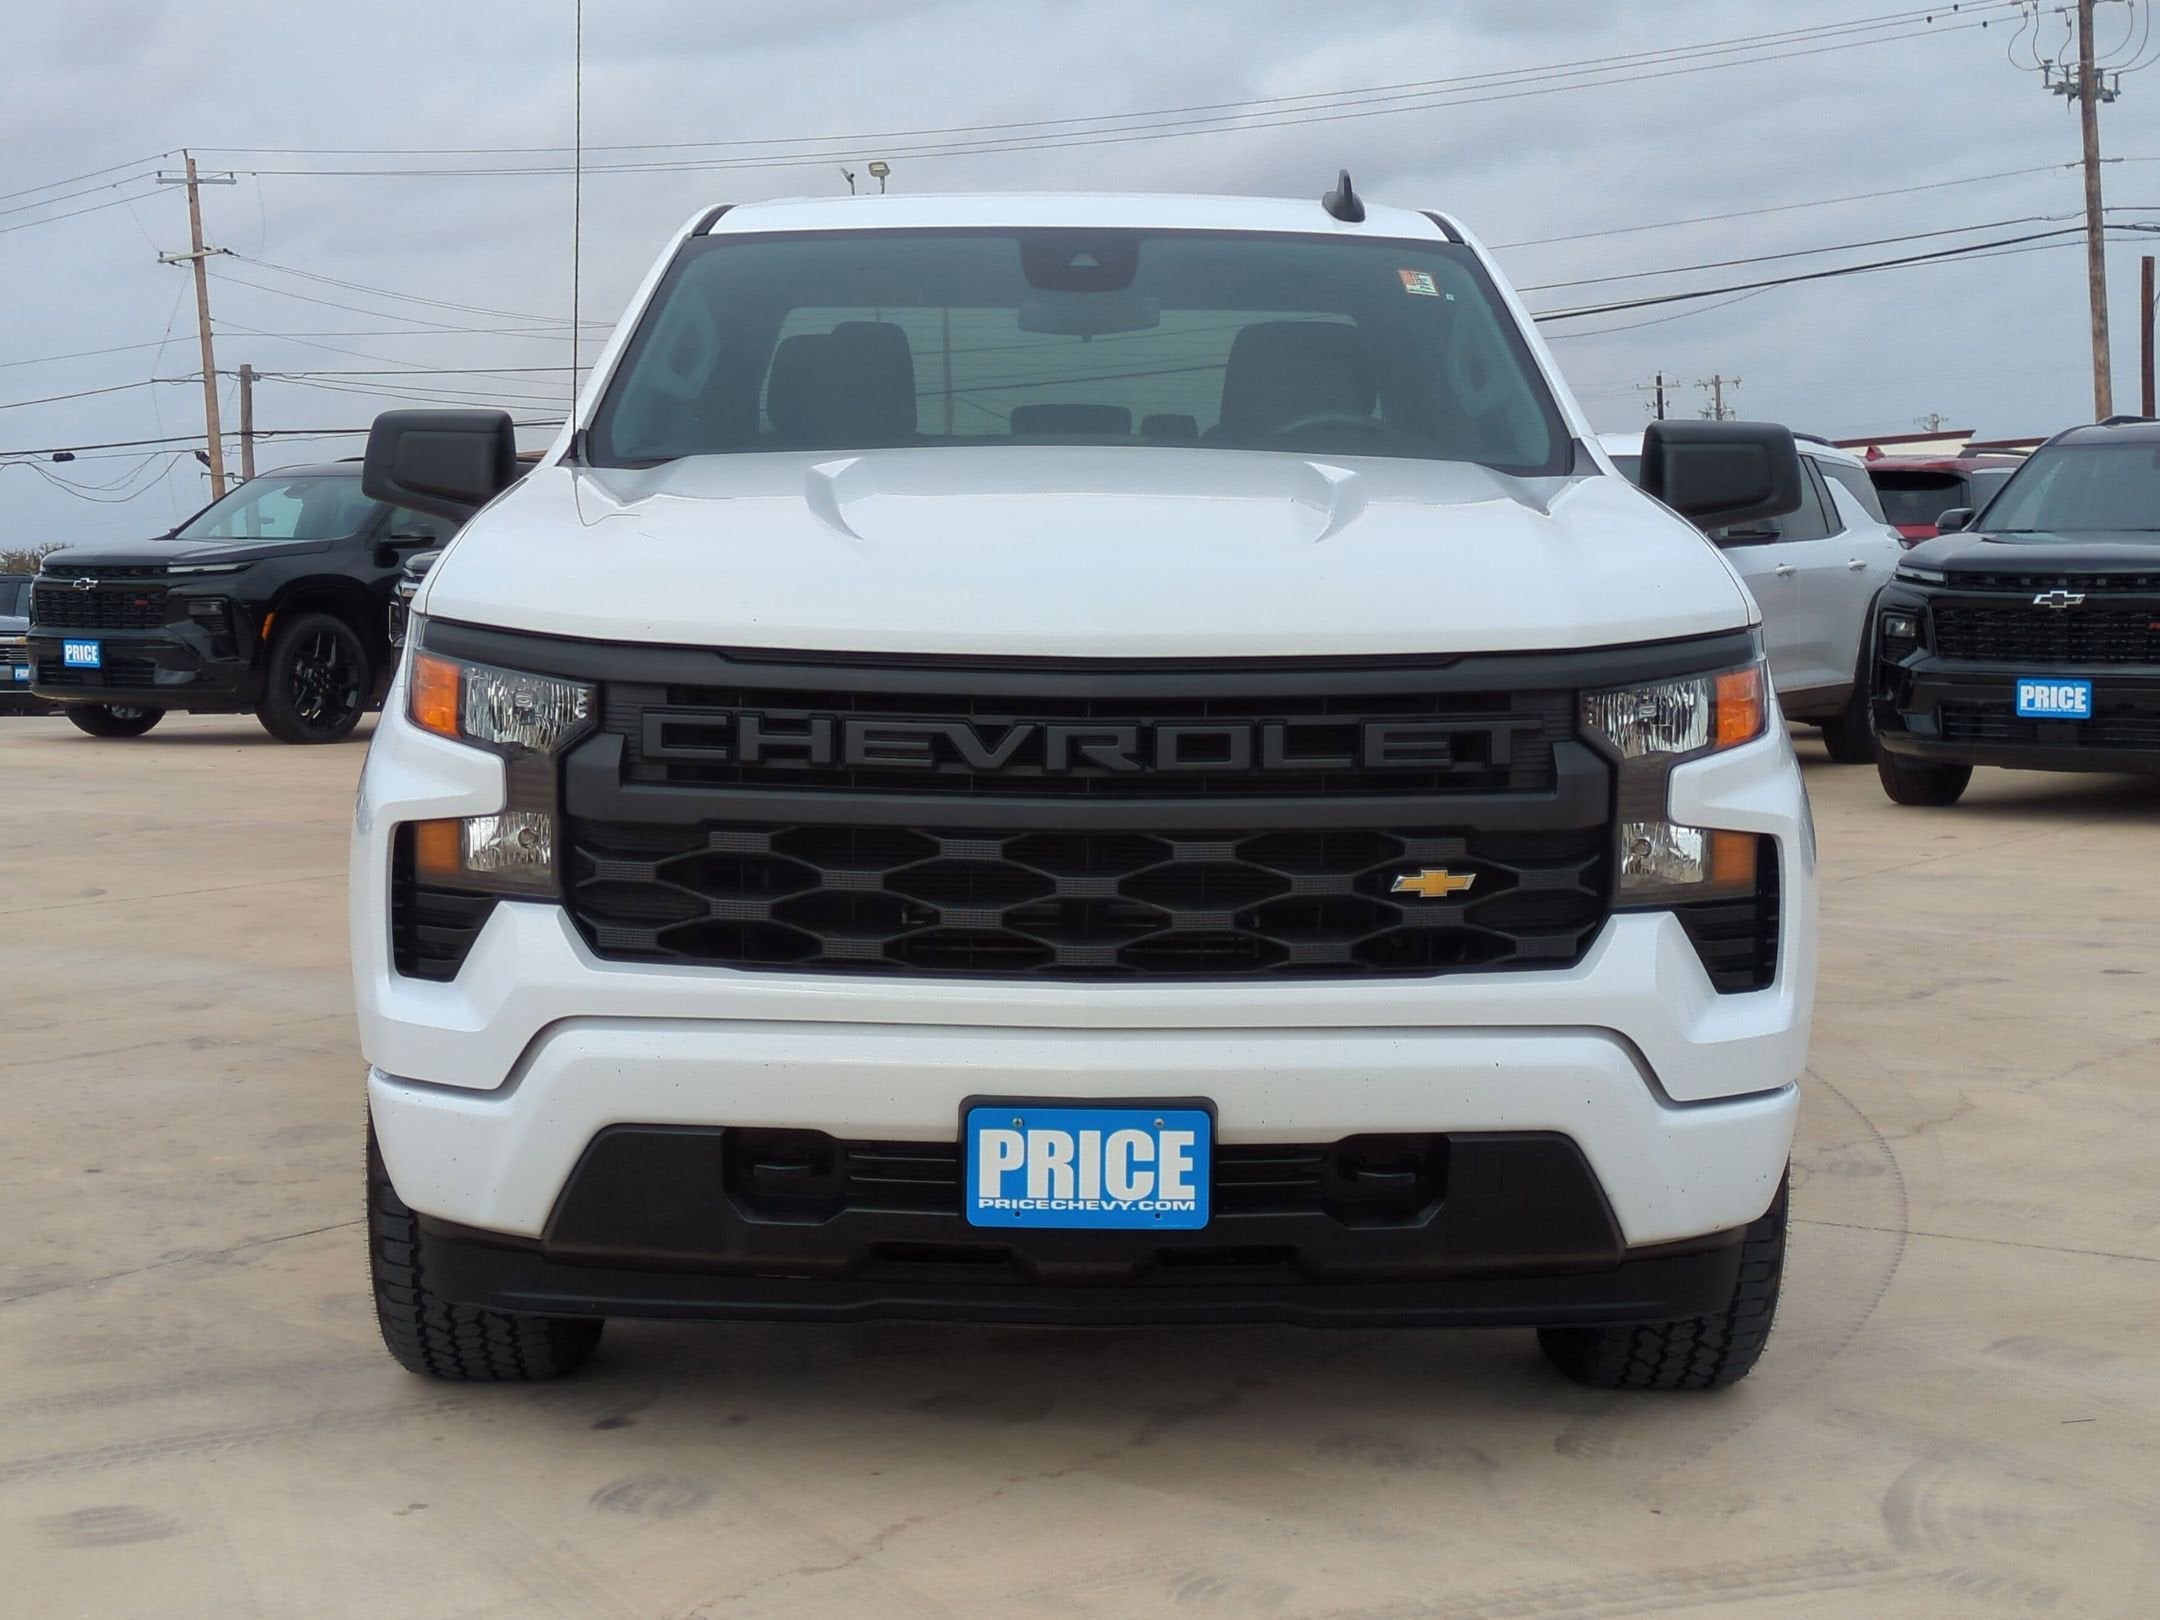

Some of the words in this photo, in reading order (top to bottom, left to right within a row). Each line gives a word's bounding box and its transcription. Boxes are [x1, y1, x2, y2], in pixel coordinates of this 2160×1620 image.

[65, 645, 98, 661] PRICE
[2020, 685, 2087, 709] PRICE
[641, 711, 1544, 770] CHEVROLET
[979, 1129, 1195, 1200] PRICE
[979, 1198, 1195, 1211] PRICECHEVY.COM
